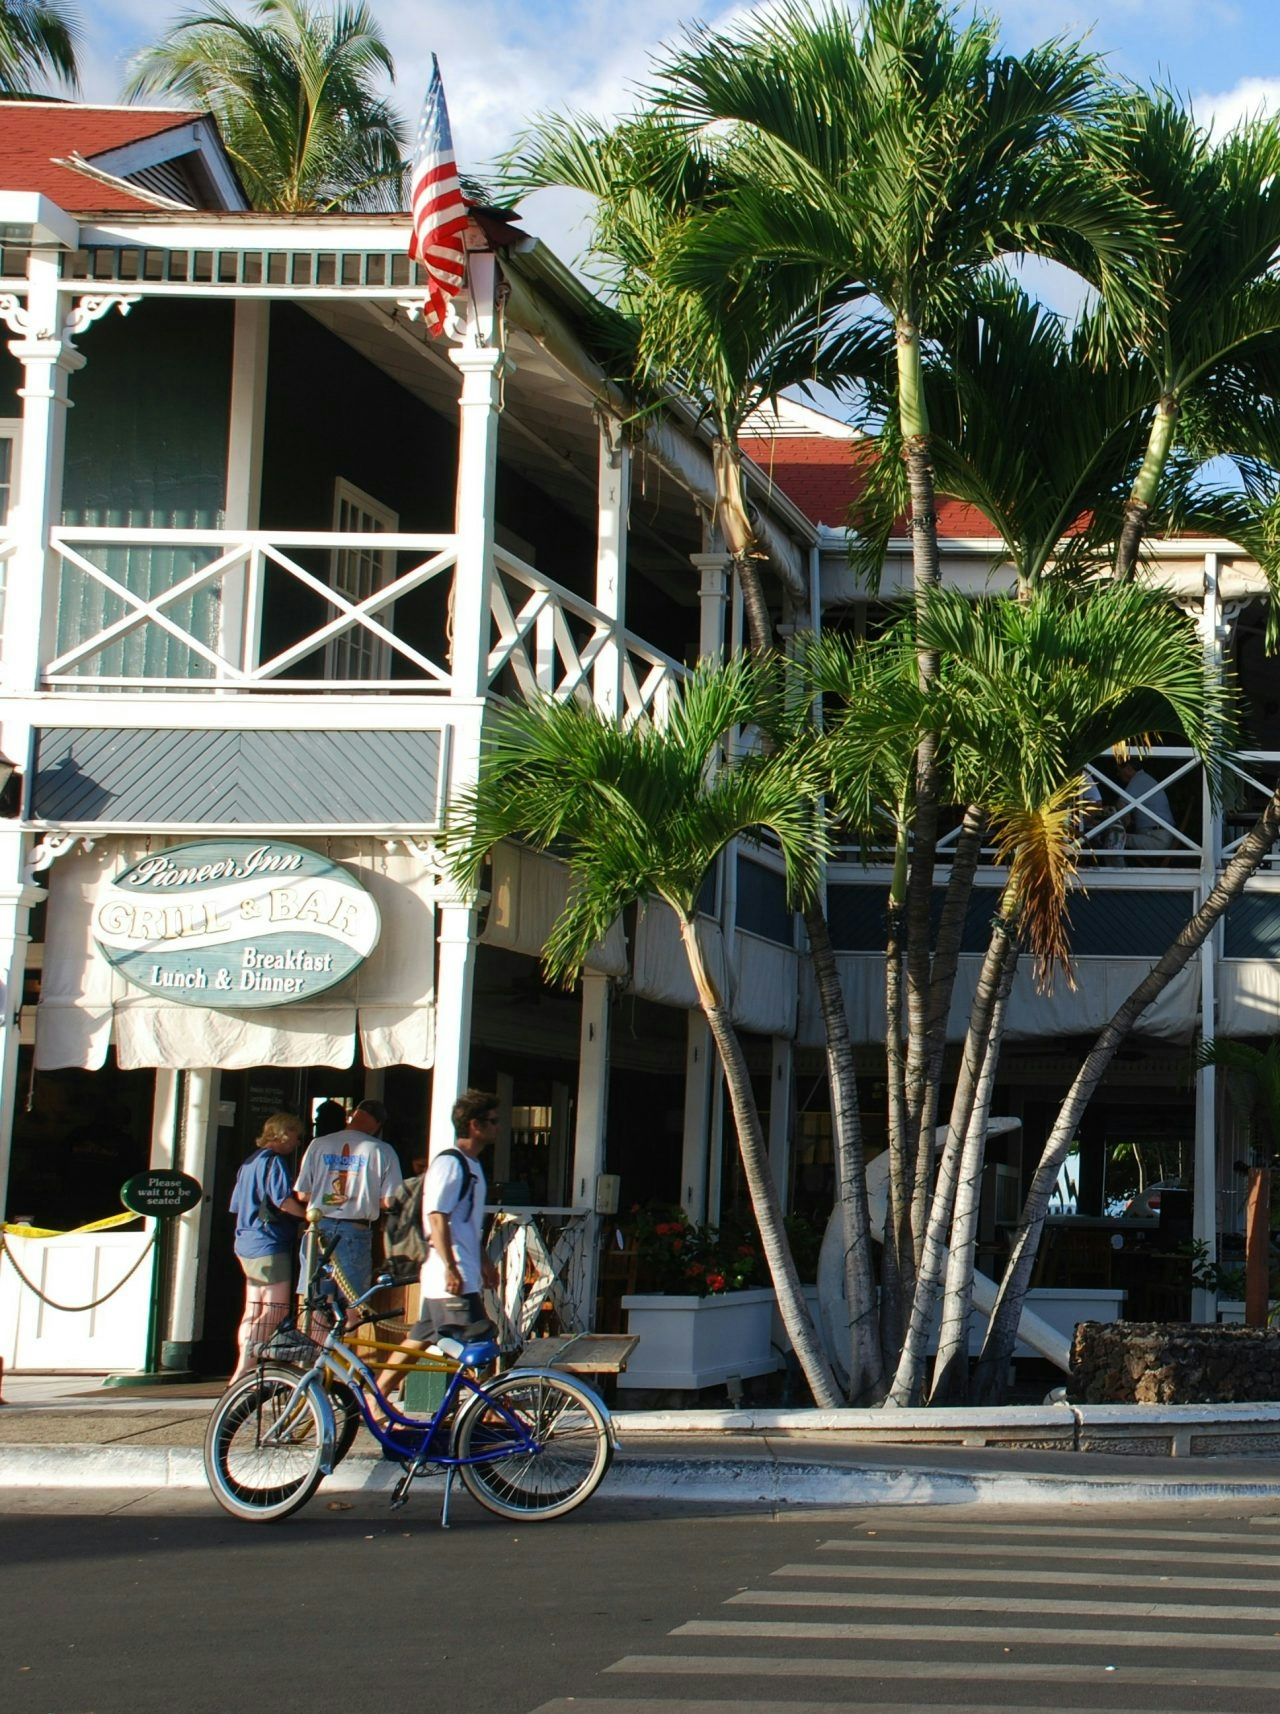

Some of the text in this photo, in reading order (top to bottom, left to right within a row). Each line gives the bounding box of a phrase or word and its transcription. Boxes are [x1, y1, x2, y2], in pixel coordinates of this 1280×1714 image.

[129, 845, 302, 887] Pioneer Inn
[99, 888, 361, 940] GRILL & BAR
[242, 947, 332, 972] Breakfast
[151, 965, 304, 993] Lunch & Dinner
[138, 1188, 191, 1196] wait to be
[149, 1178, 181, 1187] Please
[147, 1197, 181, 1205] seated
